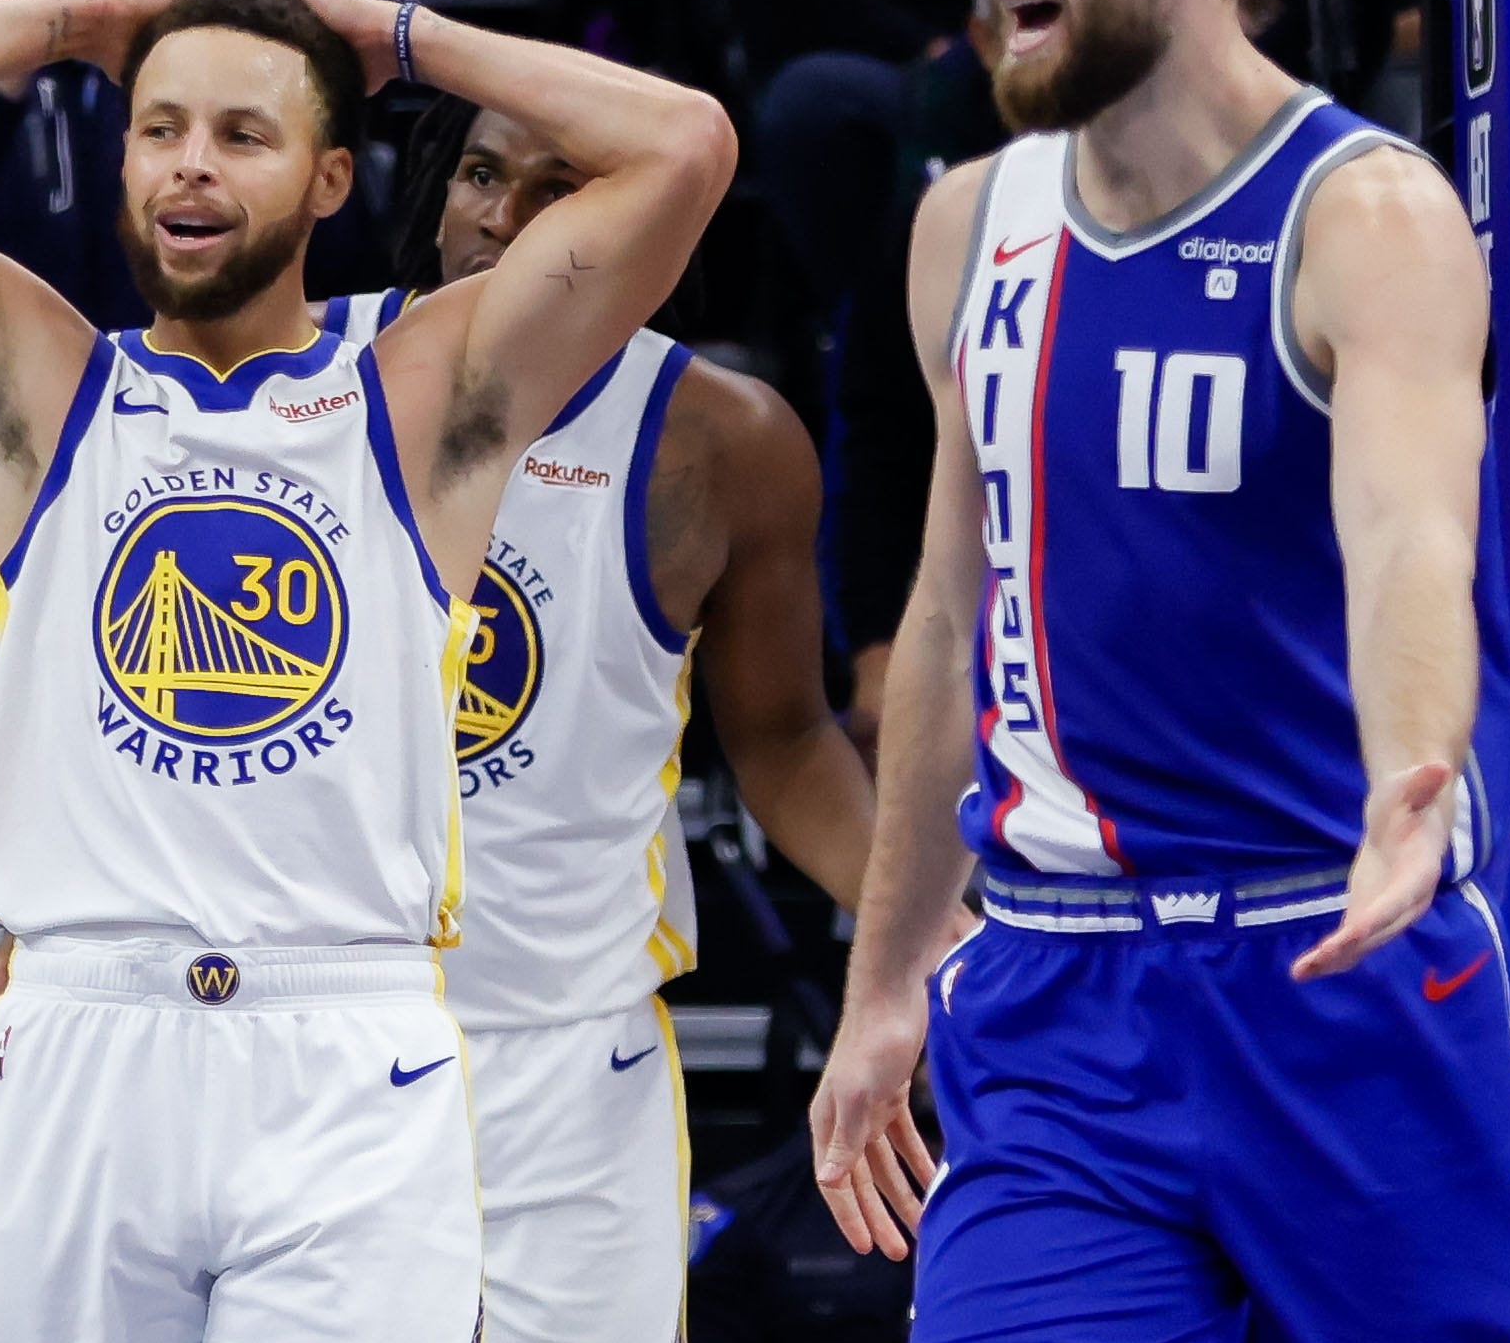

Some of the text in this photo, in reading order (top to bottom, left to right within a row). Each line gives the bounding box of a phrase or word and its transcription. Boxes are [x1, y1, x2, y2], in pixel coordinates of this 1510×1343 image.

[1179, 237, 1274, 268] dialpad
[1114, 347, 1246, 493] 10
[104, 467, 352, 547] GOLDEN STATE
[524, 457, 611, 488] Rakuten
[231, 554, 318, 625] 30
[97, 685, 356, 787] WARRIORS
[191, 966, 236, 997] W
